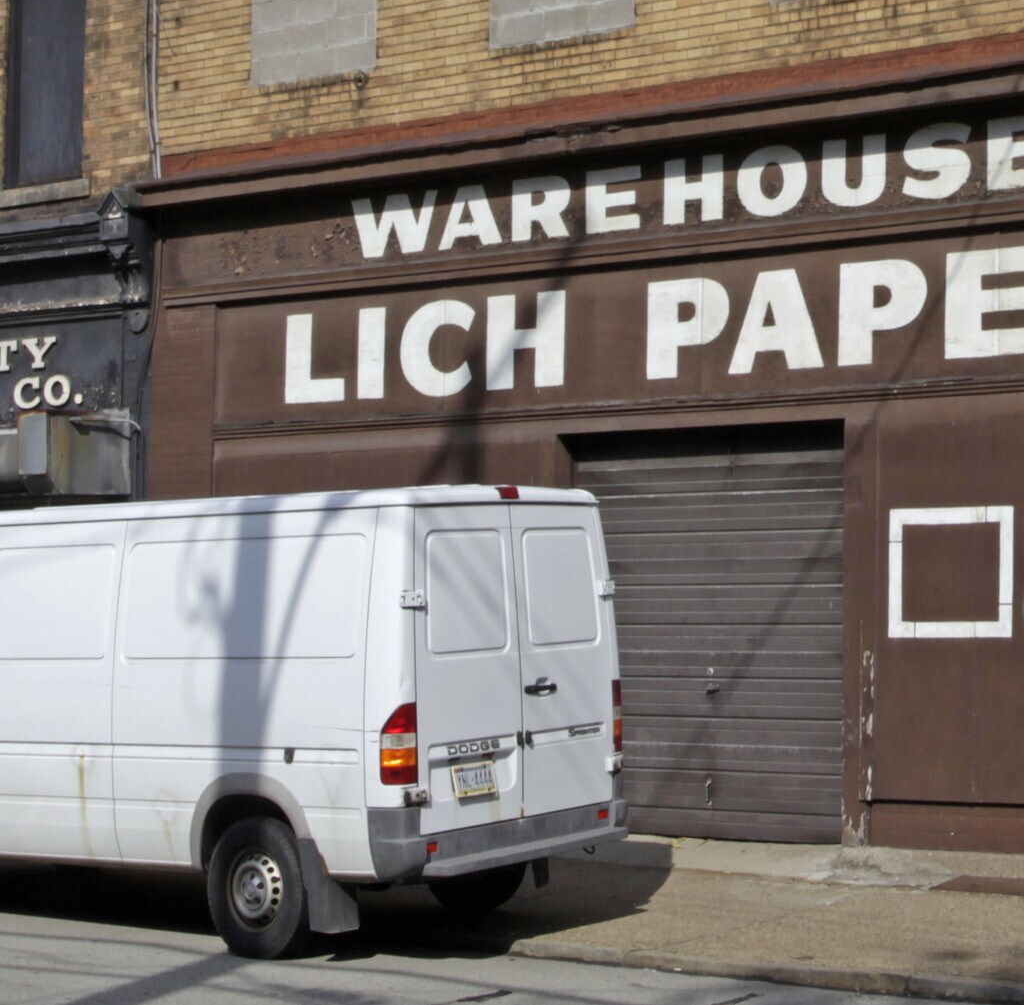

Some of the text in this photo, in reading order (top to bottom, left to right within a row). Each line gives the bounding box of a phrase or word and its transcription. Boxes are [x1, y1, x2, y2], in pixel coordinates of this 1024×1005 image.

[284, 289, 567, 405] LICH
[13, 374, 83, 409] CO.
[447, 739, 500, 756] DODGE
